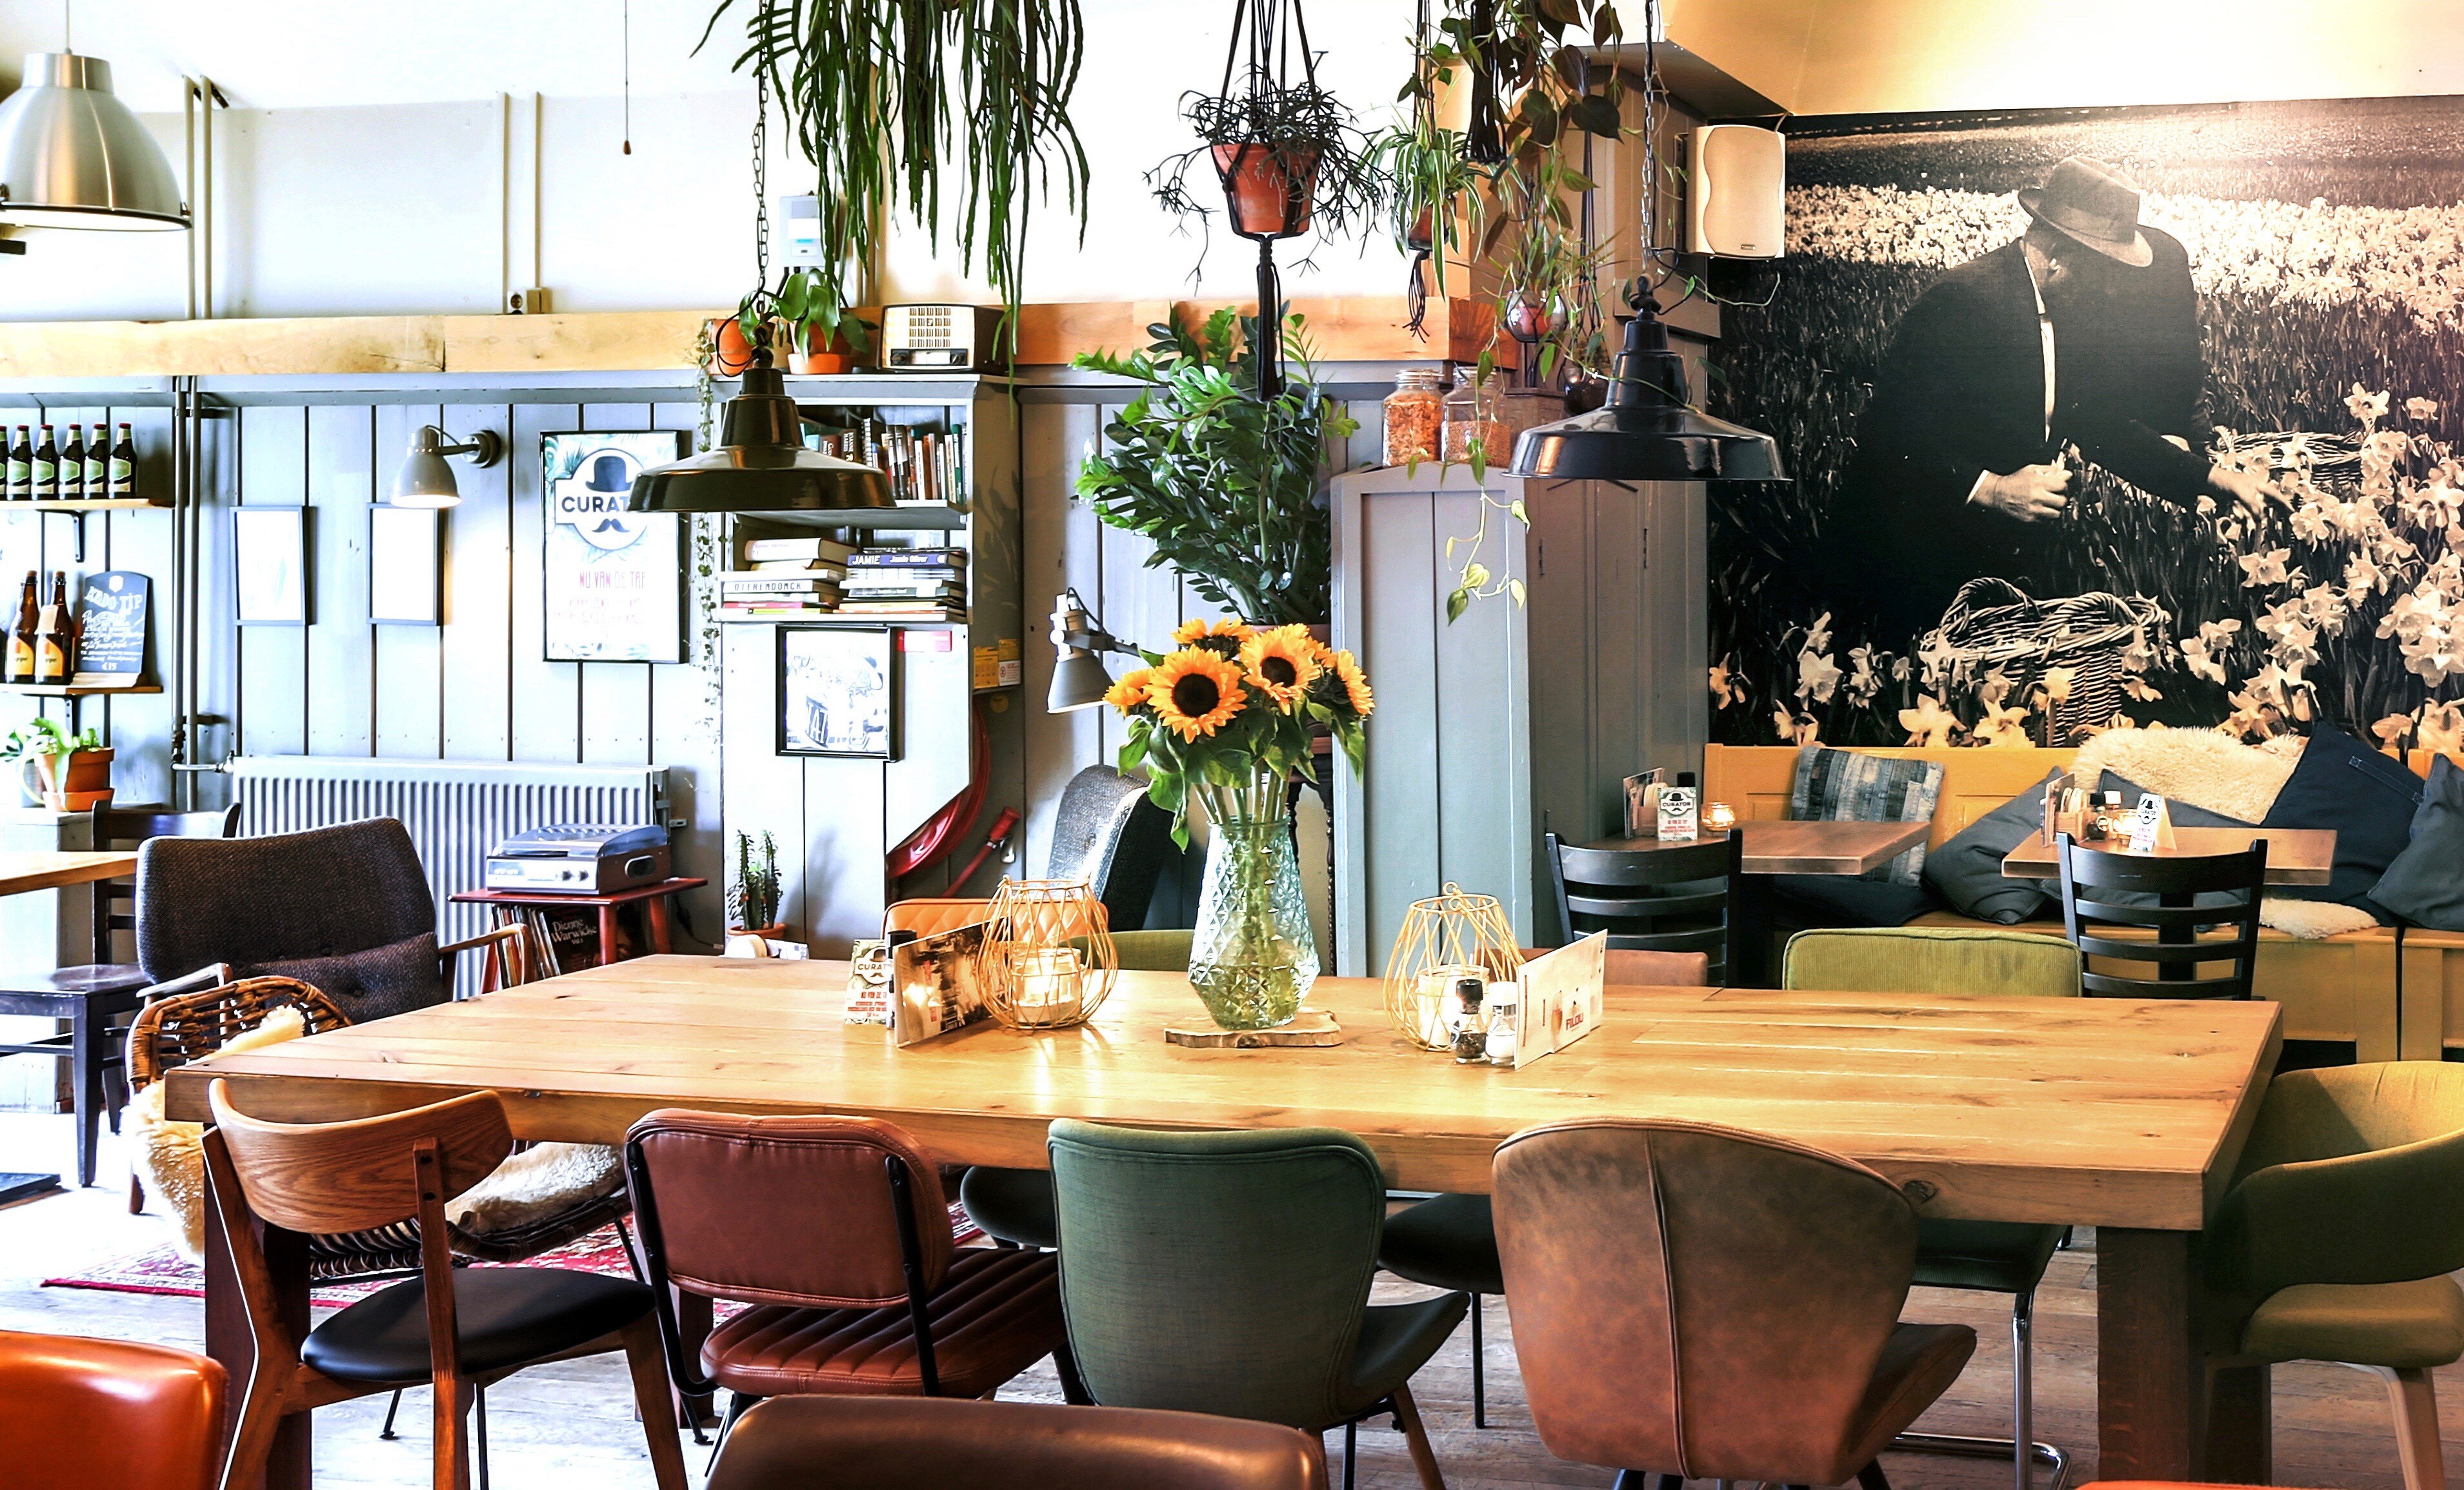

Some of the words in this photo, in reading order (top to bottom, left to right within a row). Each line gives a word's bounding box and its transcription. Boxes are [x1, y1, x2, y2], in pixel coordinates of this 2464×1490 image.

[561, 496, 630, 513] CURAT
[852, 555, 881, 565] JAMIE
[594, 571, 611, 589] VAN
